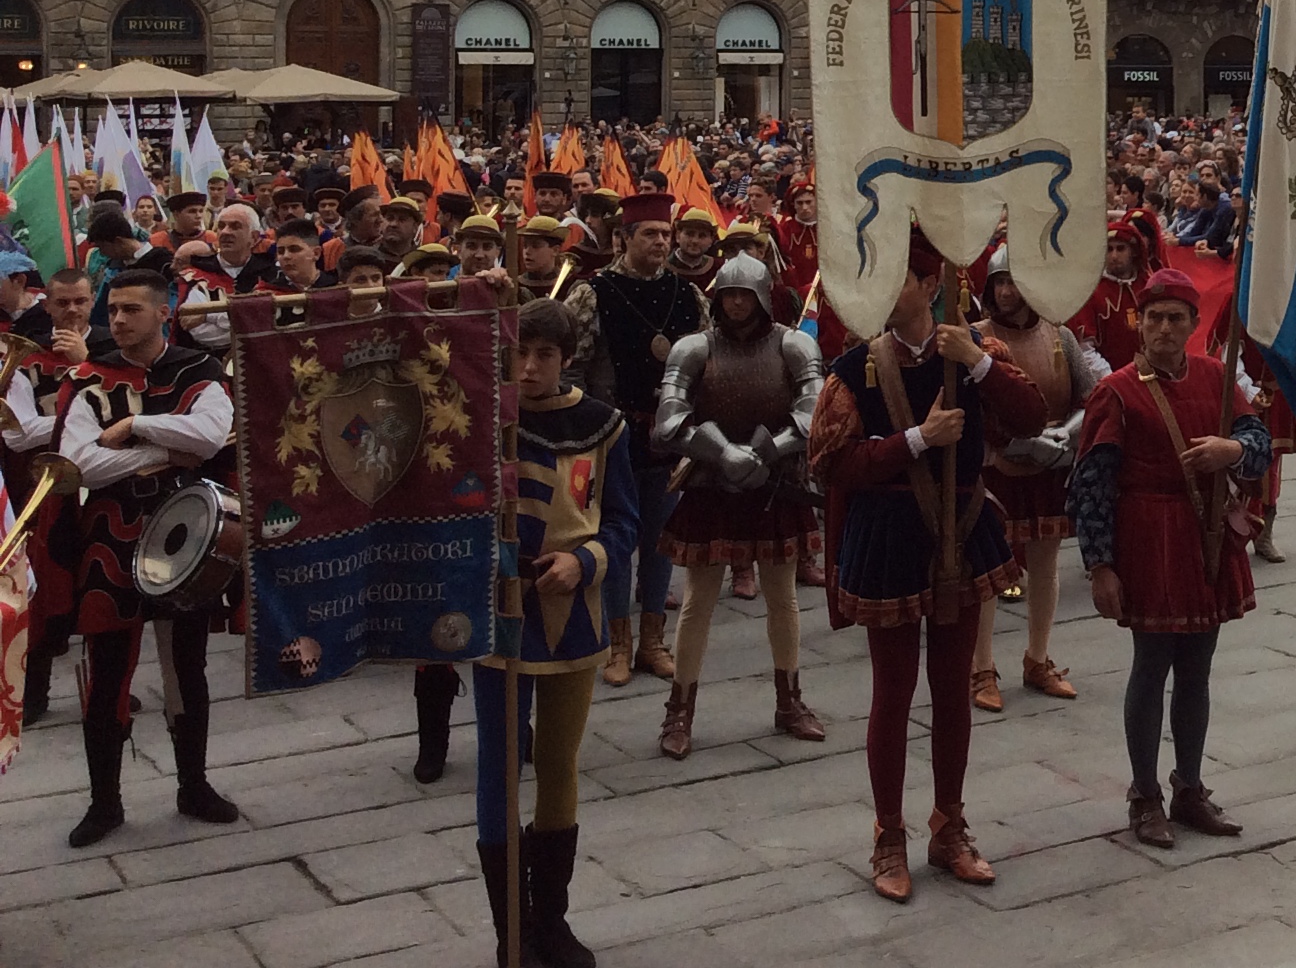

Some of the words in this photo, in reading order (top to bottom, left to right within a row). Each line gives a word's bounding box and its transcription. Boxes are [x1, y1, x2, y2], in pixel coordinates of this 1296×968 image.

[128, 20, 187, 30] RIVOIRE
[465, 38, 520, 47] CHANEL
[599, 38, 650, 47] CHANEL
[724, 39, 771, 48] CHANEL
[1124, 71, 1159, 81] FOSSIL
[1219, 71, 1252, 81] FOSSIL
[903, 149, 1023, 180] LIBERTAS
[307, 595, 354, 622] SAN
